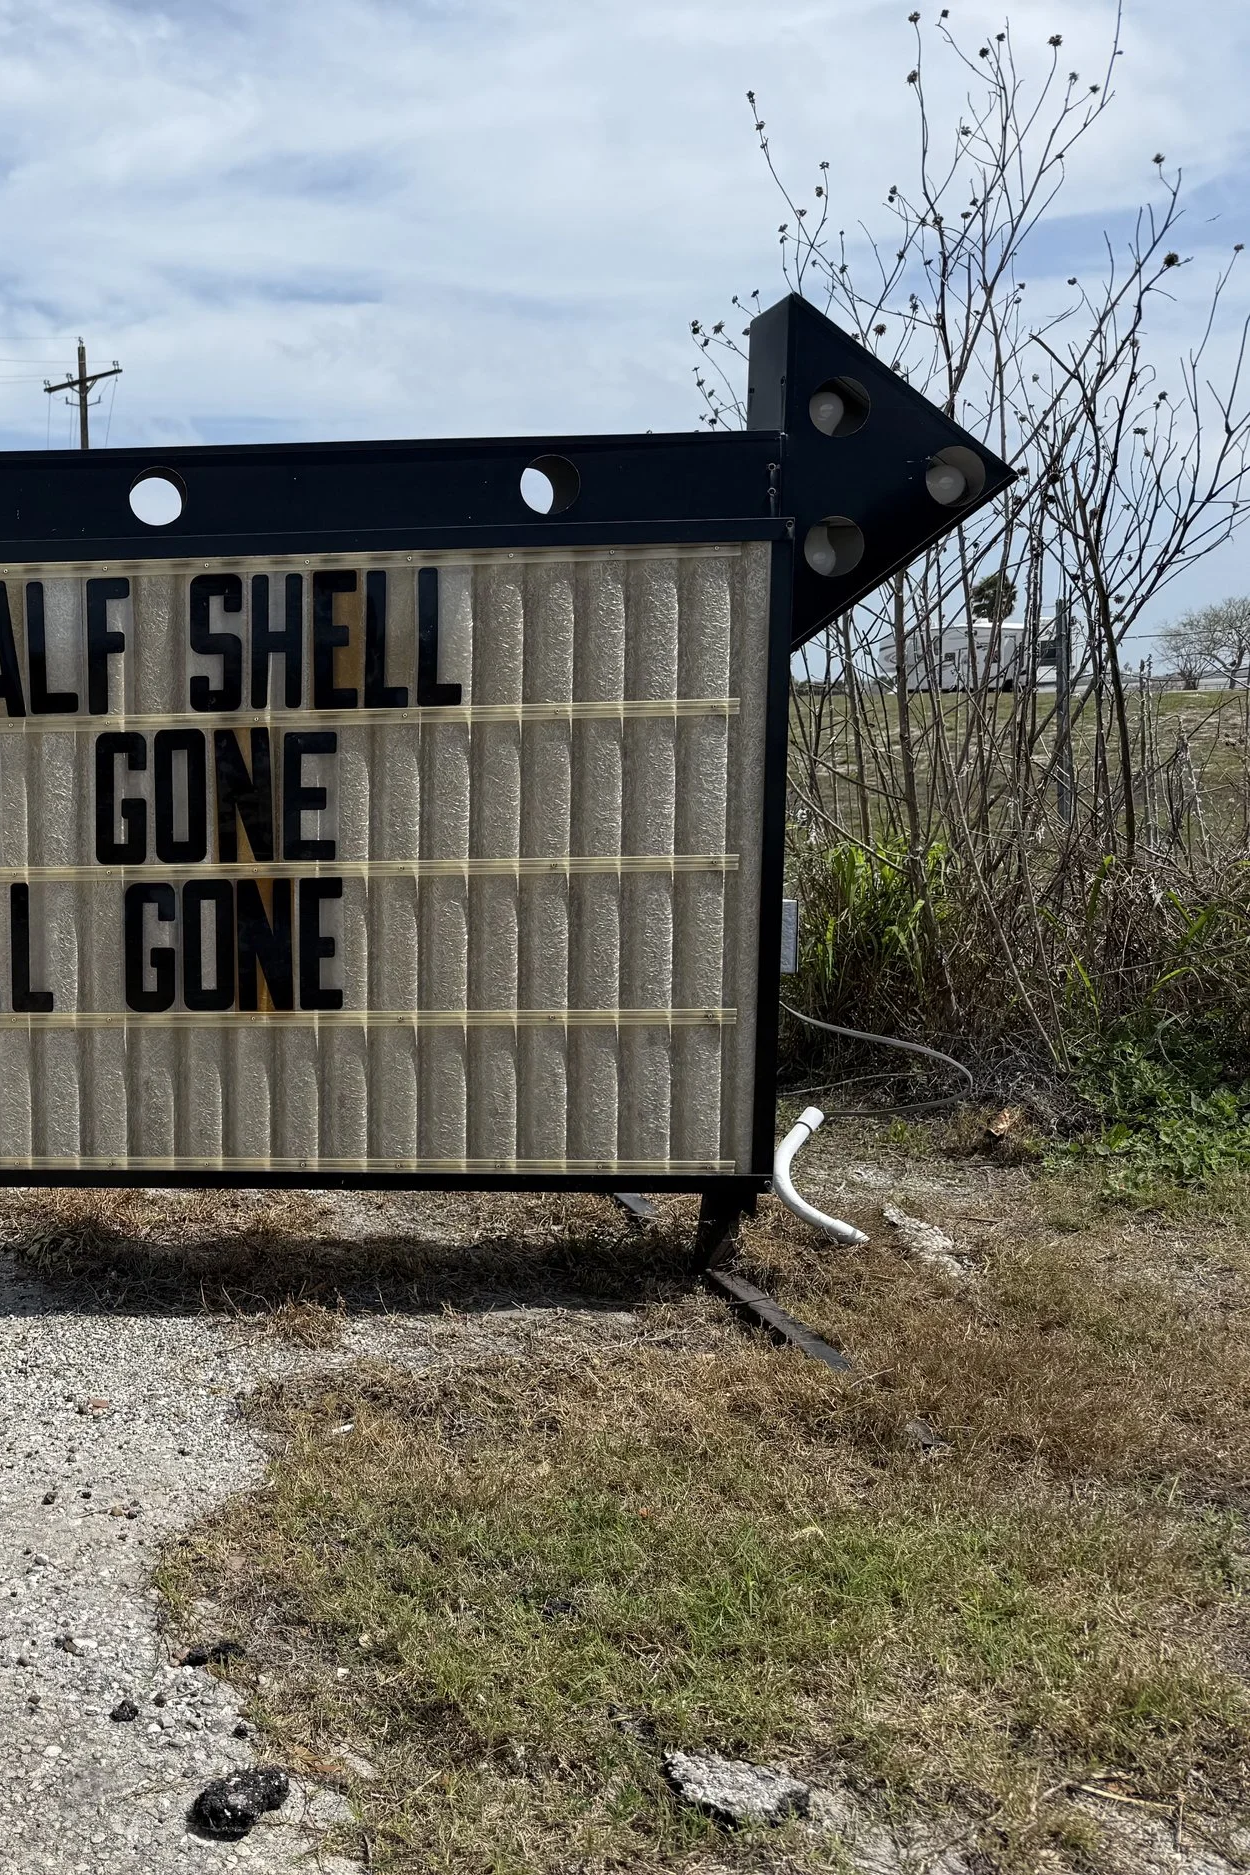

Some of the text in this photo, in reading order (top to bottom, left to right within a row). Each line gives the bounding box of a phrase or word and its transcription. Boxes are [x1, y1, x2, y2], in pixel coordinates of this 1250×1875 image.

[189, 567, 462, 713] SHELL
[95, 727, 338, 865] GONE
[124, 877, 343, 1013] GONE
